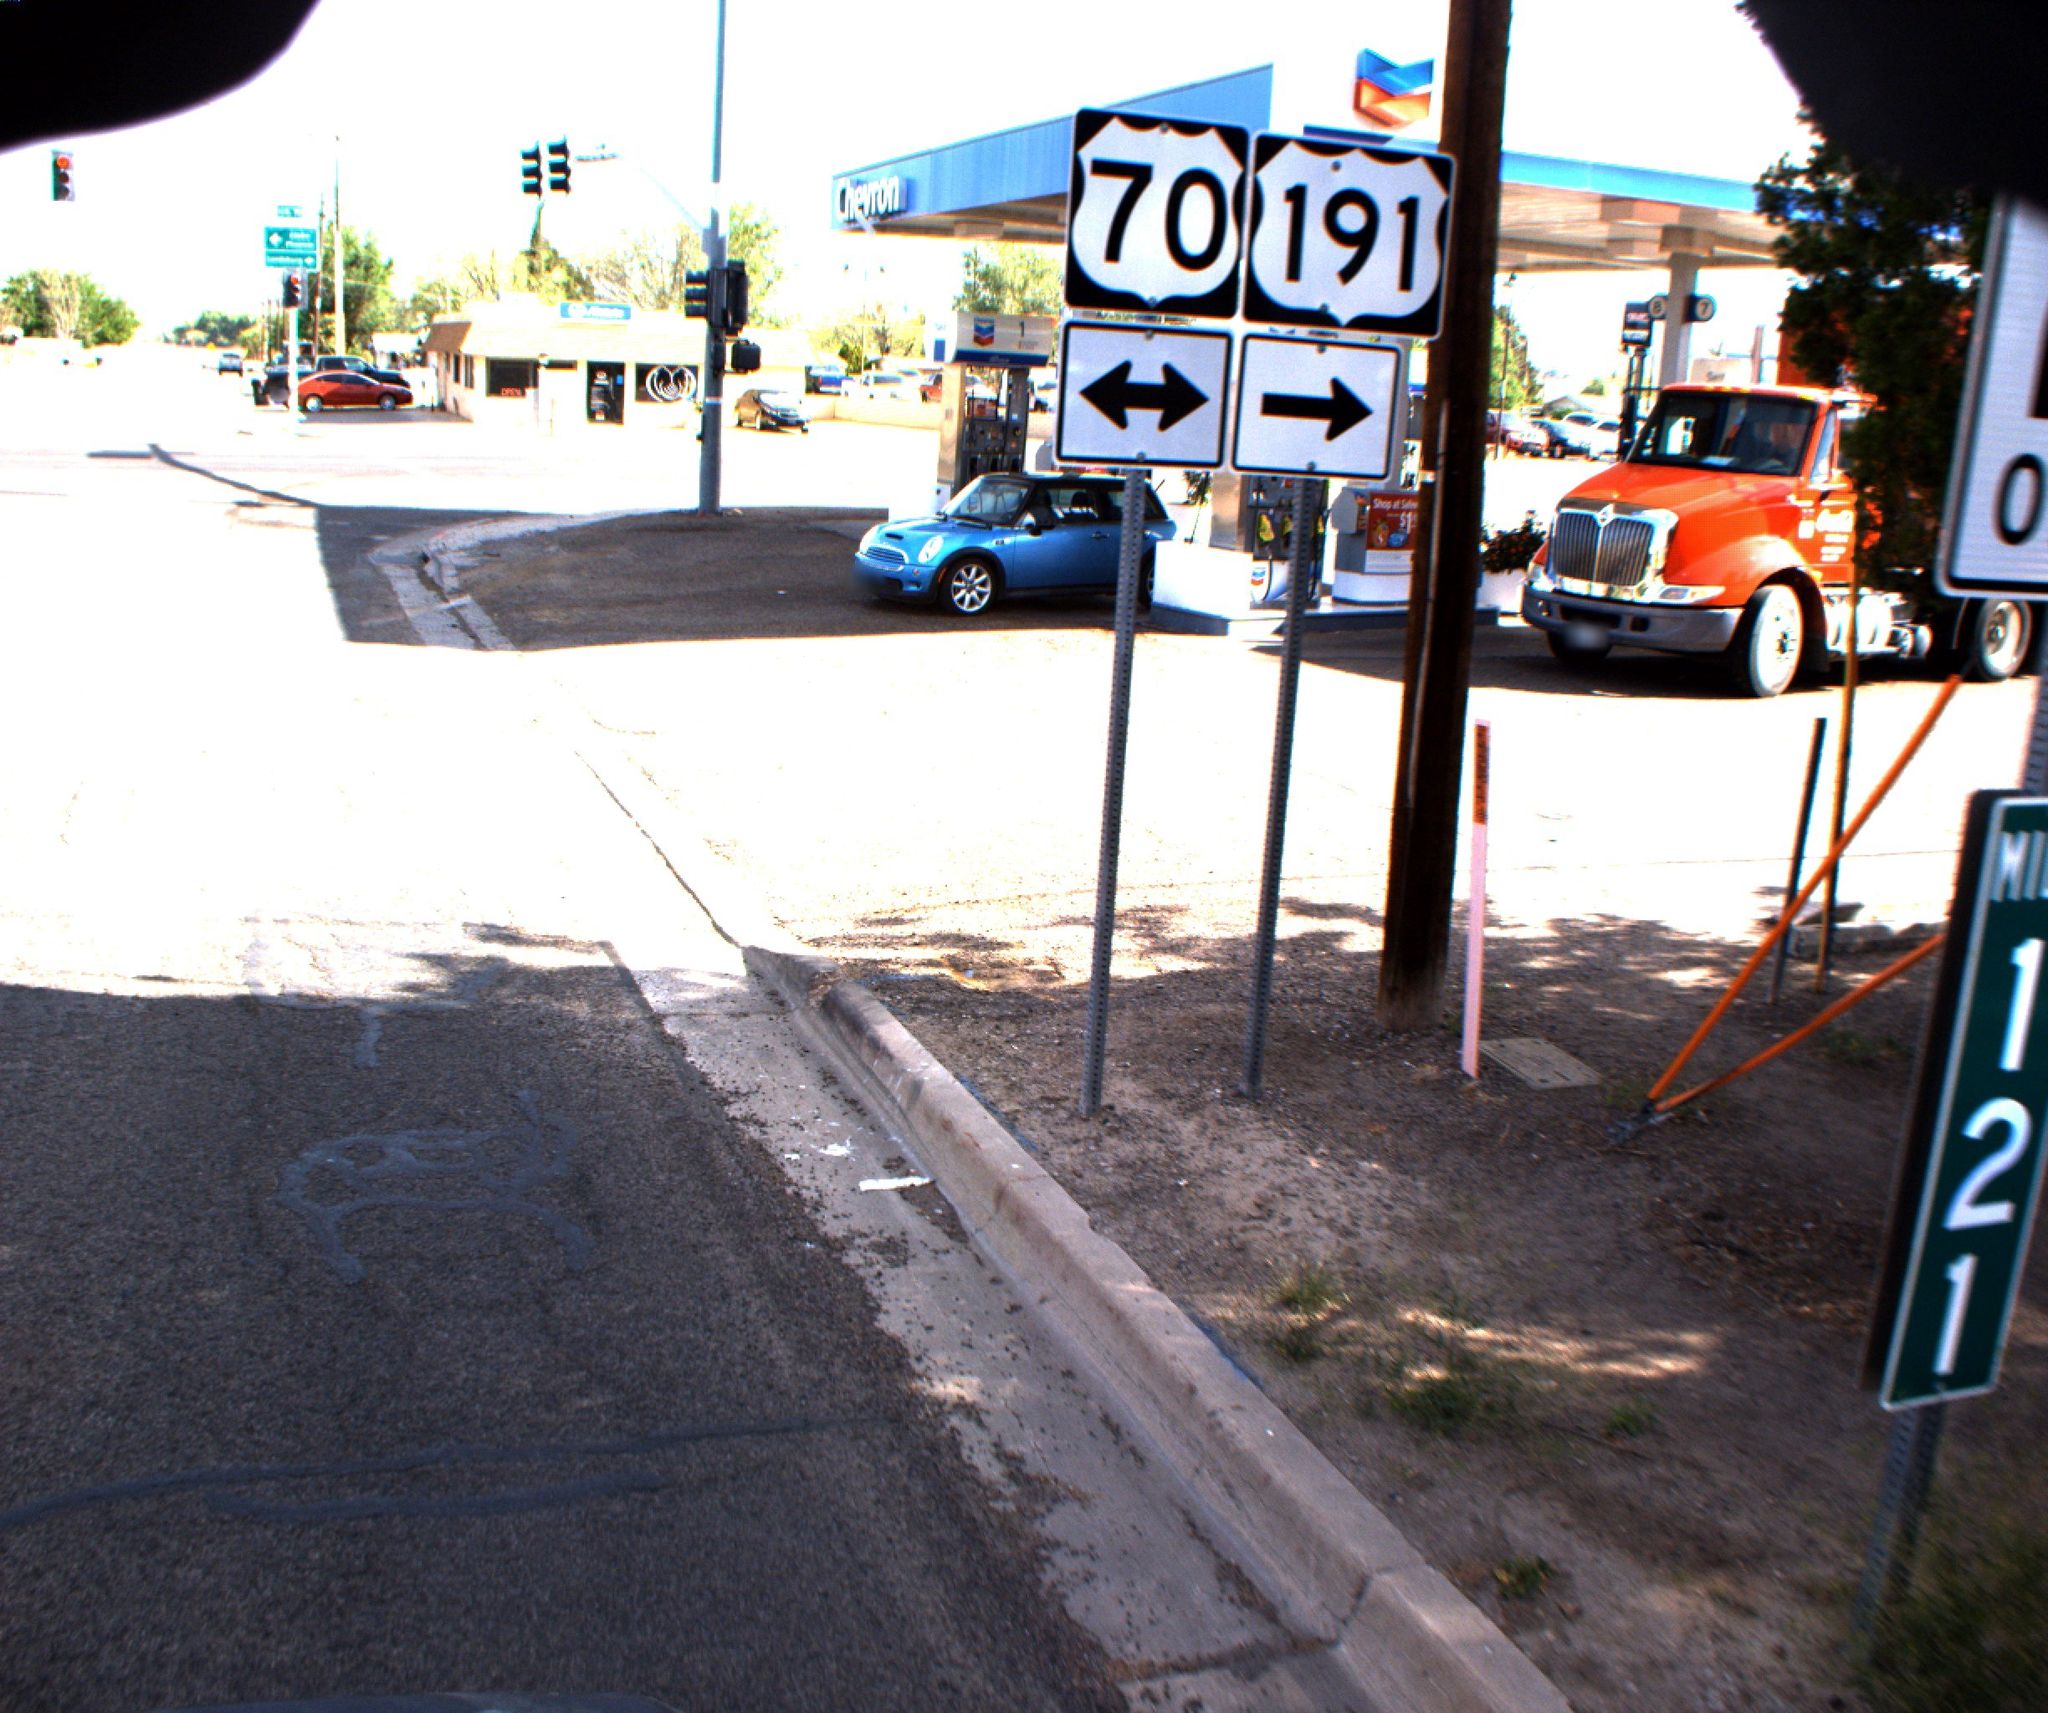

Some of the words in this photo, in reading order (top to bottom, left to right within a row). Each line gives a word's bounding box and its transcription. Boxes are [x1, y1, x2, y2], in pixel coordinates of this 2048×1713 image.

[836, 176, 899, 221] Chevron
[1090, 158, 1228, 272] 70
[1284, 184, 1420, 292] 191
